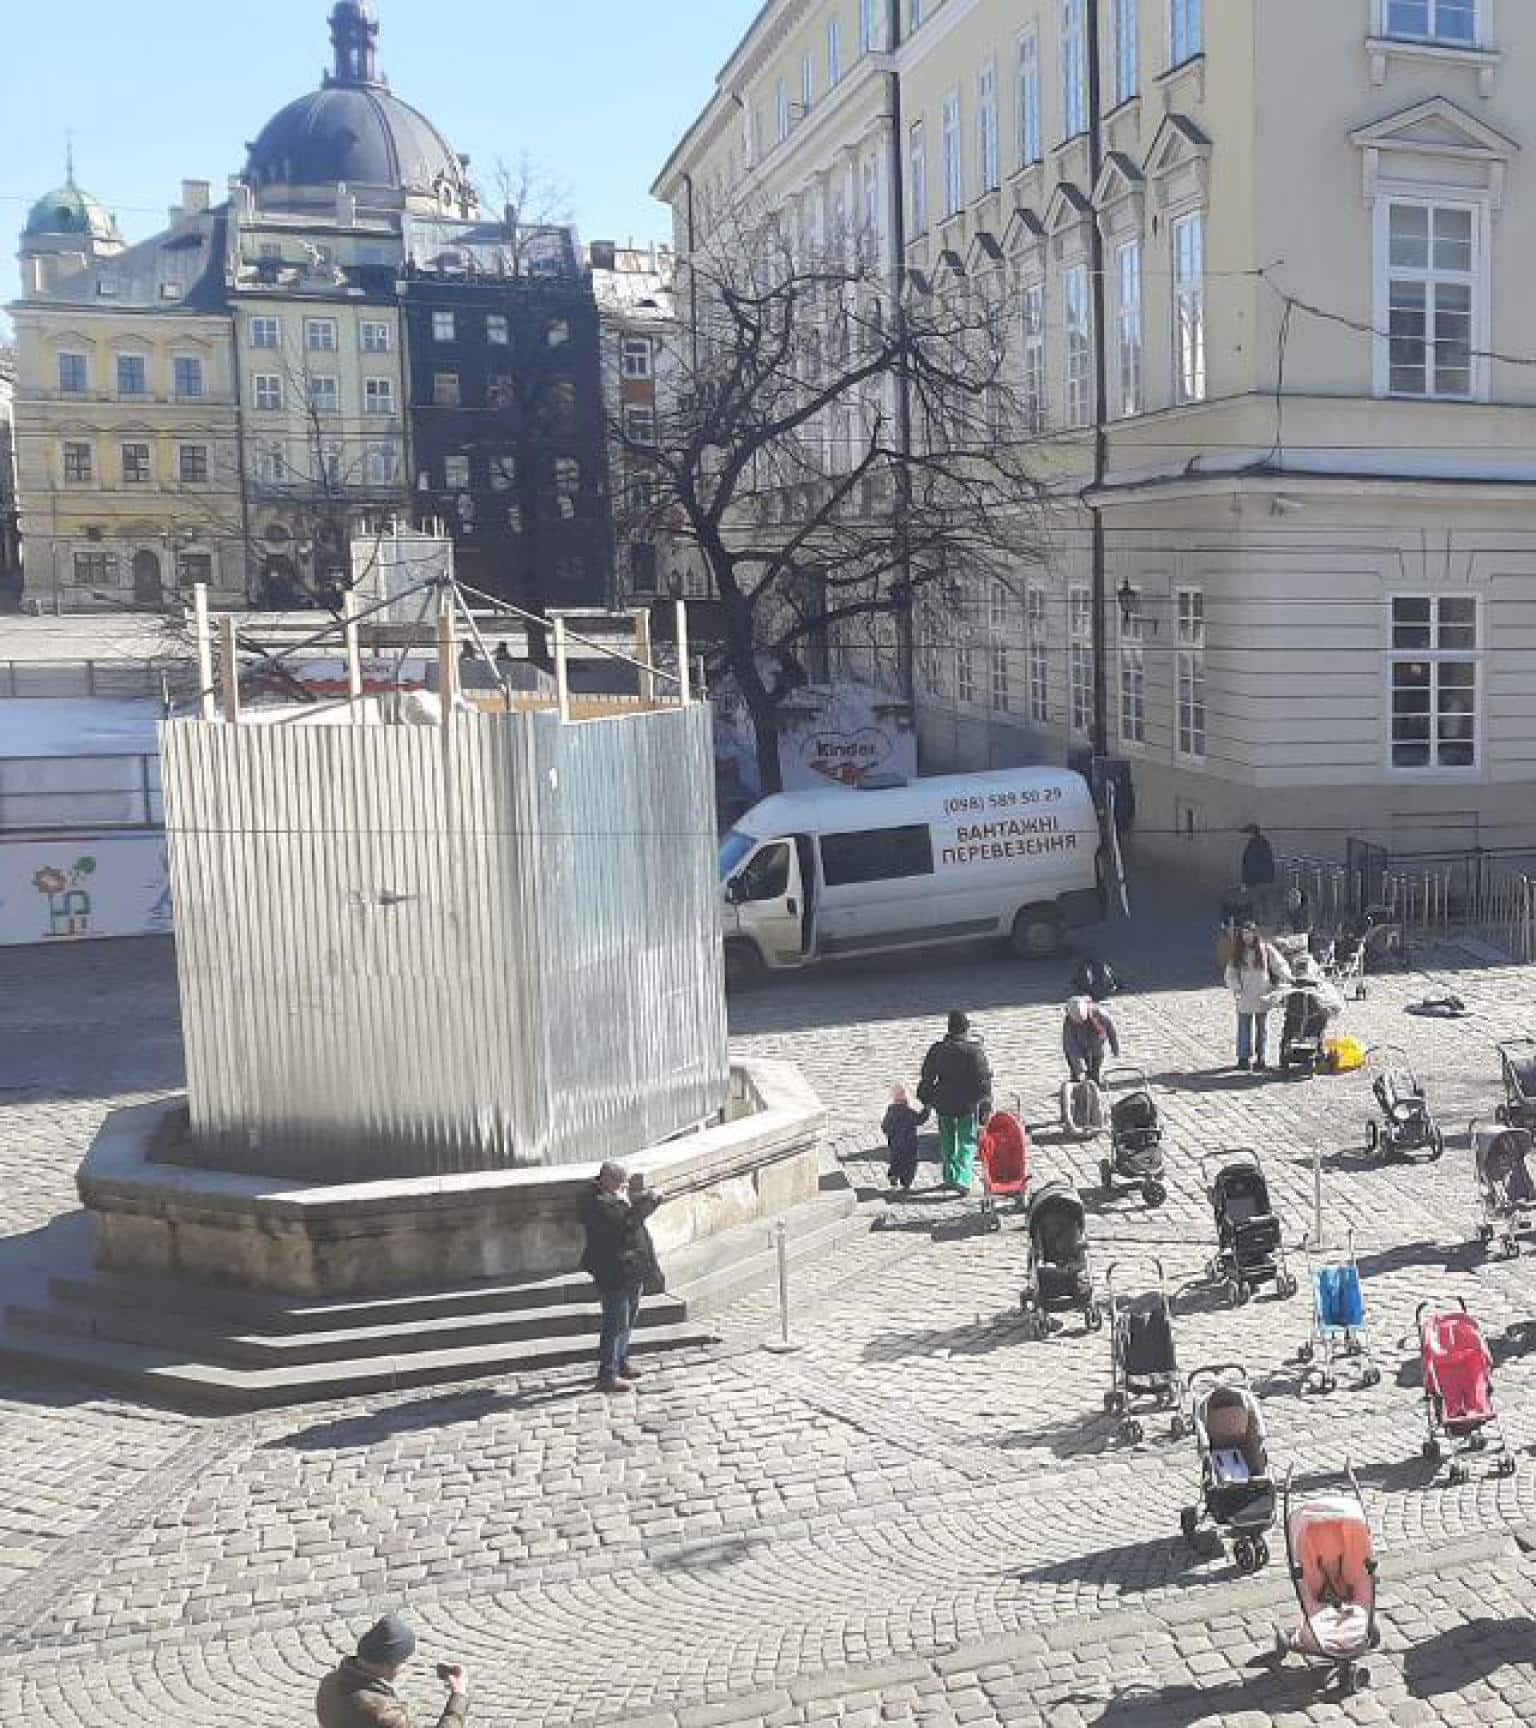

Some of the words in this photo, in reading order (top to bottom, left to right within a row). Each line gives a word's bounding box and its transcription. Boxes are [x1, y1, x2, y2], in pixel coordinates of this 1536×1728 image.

[816, 739, 875, 757] Kinder
[957, 815, 1057, 842] ВАНТАЖНІ
[942, 834, 1076, 865] ПЕРЕВЕЗЕННЯ
